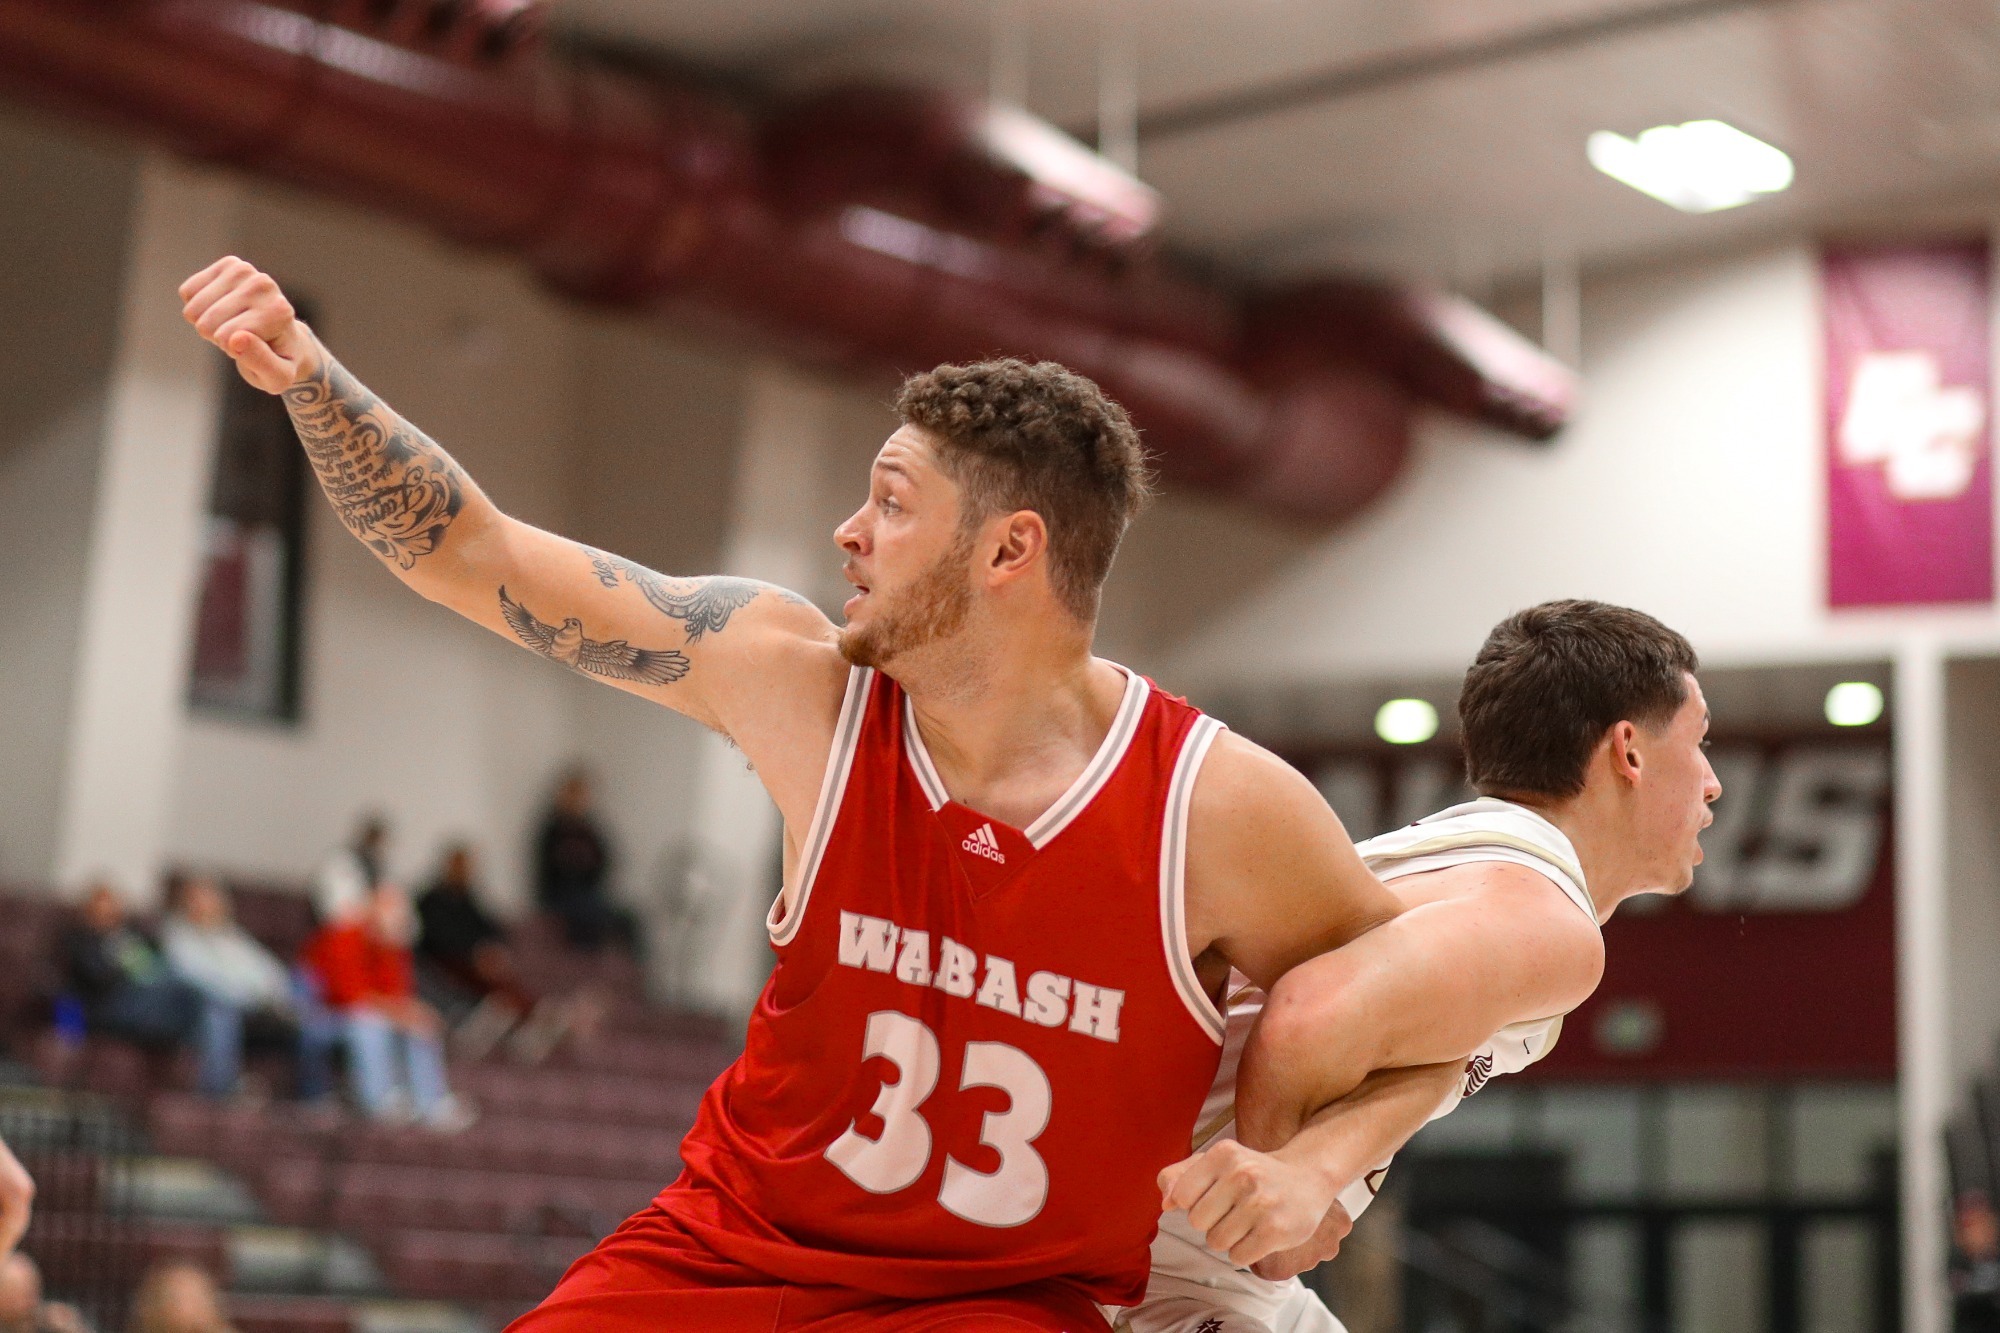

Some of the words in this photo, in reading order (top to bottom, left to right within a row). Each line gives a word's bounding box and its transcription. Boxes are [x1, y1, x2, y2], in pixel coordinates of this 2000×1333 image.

[962, 839, 1005, 864] adidas
[838, 909, 1125, 1043] WABASH
[823, 1009, 1052, 1228] 33
